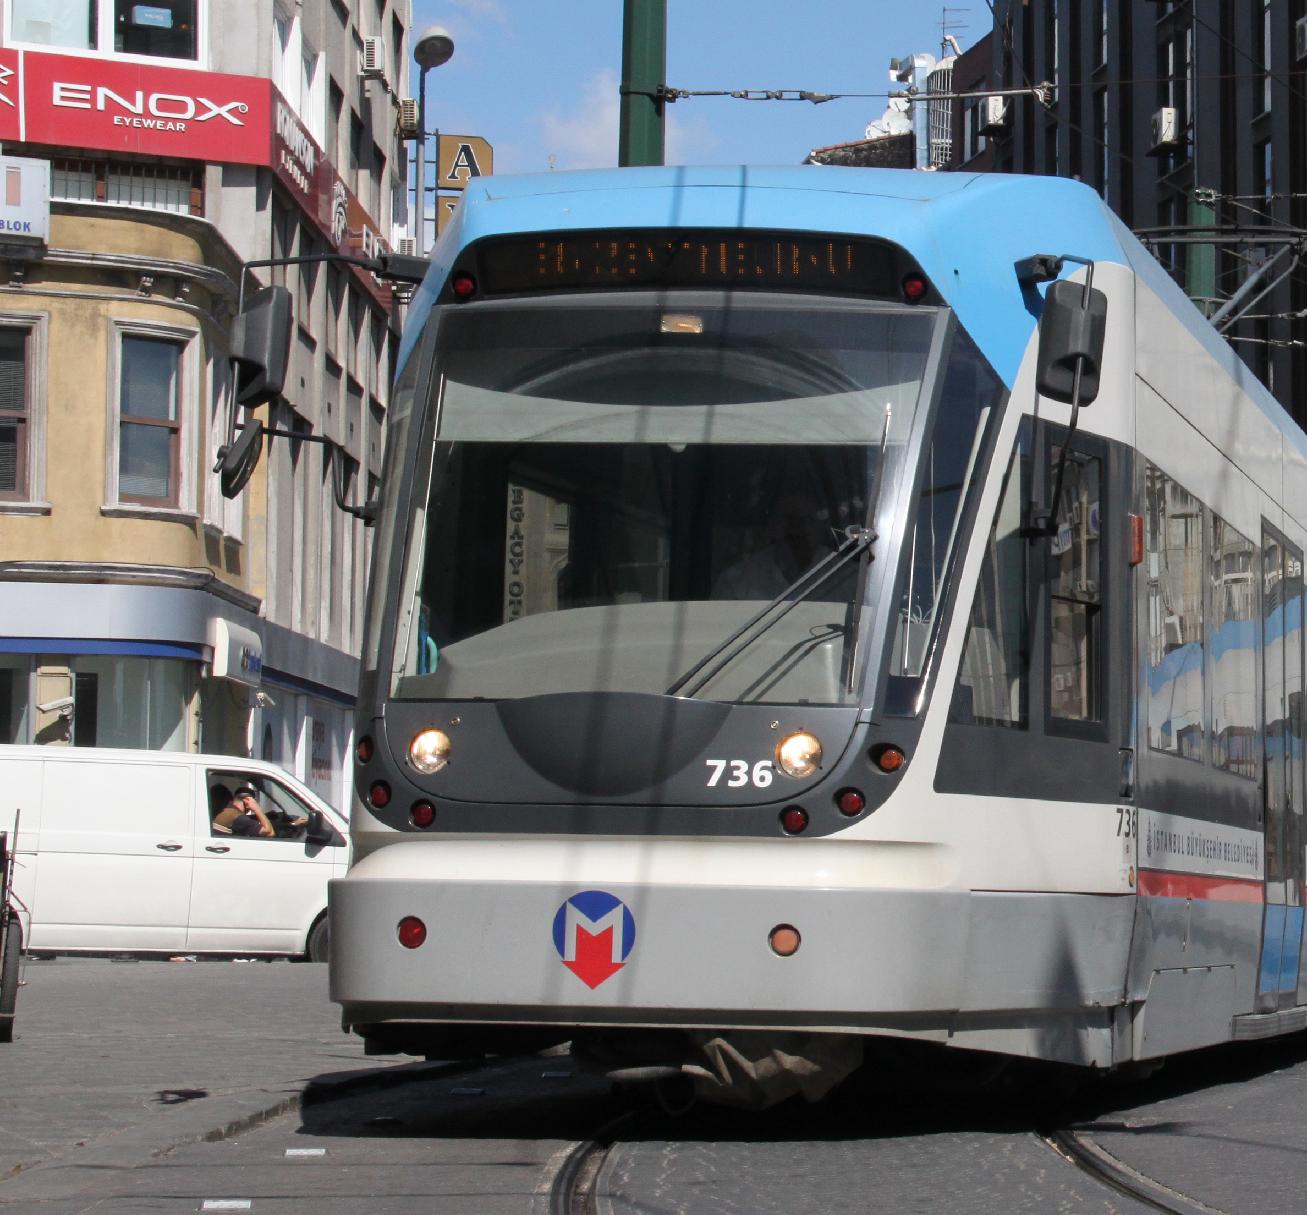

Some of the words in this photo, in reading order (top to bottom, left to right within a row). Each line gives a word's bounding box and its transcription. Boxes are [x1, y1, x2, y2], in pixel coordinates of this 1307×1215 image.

[113, 115, 186, 132] EYEWEAR
[446, 143, 482, 181] A
[705, 759, 773, 788] 736
[1116, 808, 1137, 838] 736
